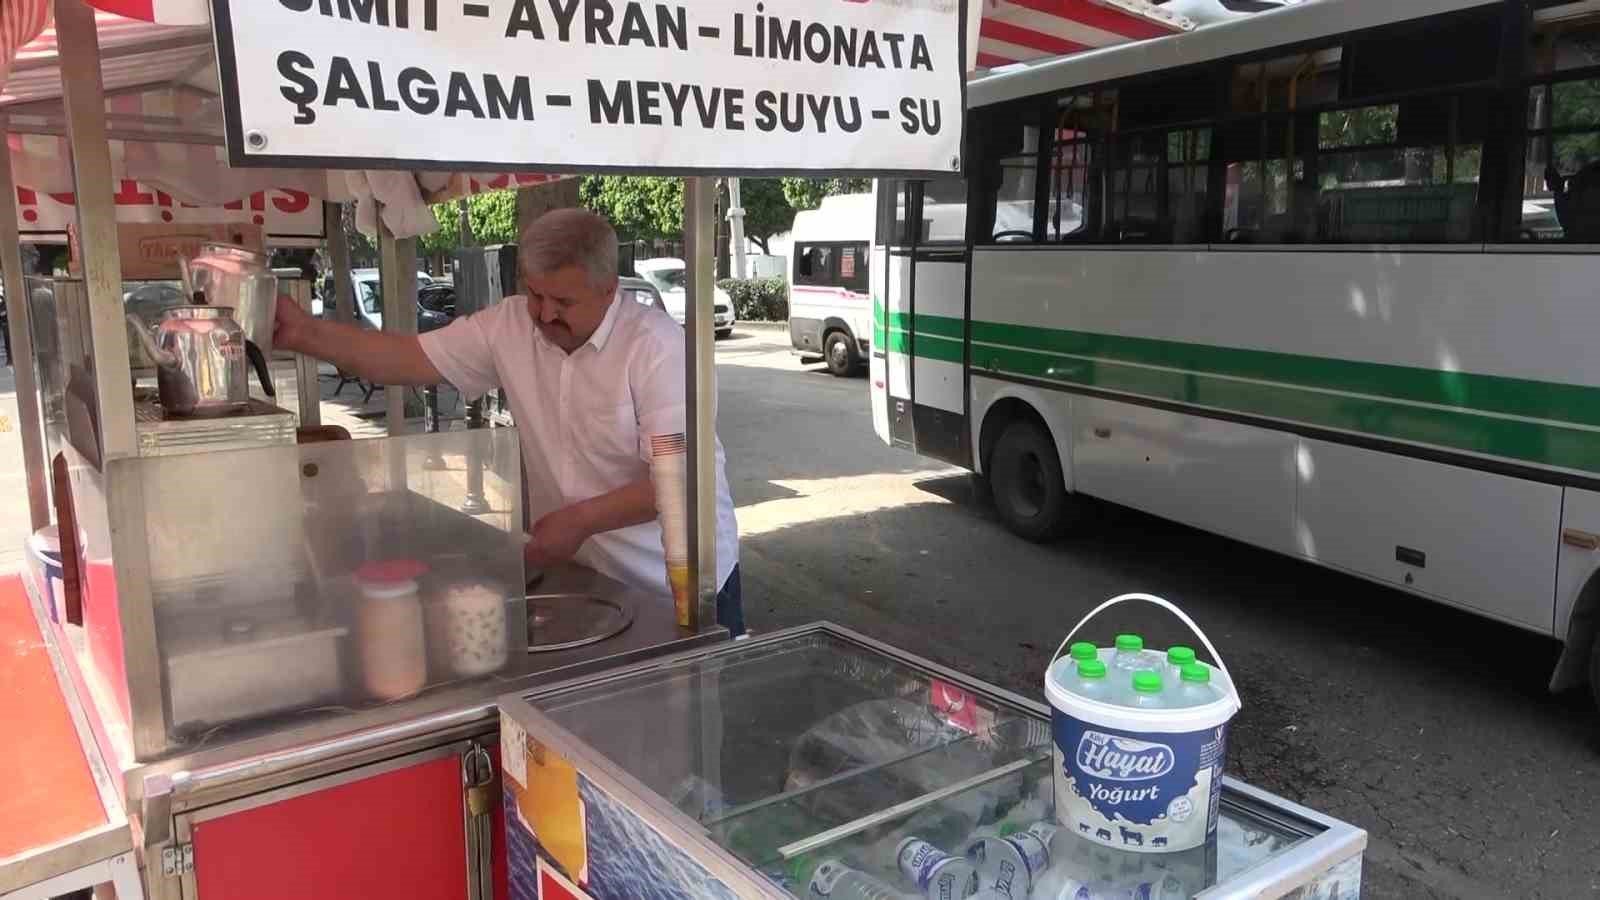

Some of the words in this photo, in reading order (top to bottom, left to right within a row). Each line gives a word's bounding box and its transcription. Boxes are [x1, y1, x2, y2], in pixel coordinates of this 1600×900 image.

[505, 0, 687, 50] AYRAN
[734, 2, 933, 71] LİMONATA
[277, 51, 534, 124] ŞALGAM
[588, 80, 744, 131] MEYVE
[755, 91, 861, 132] SUYU
[900, 98, 940, 135] SU
[1084, 741, 1166, 777] Hayat
[1089, 783, 1160, 805] Yoğurt
